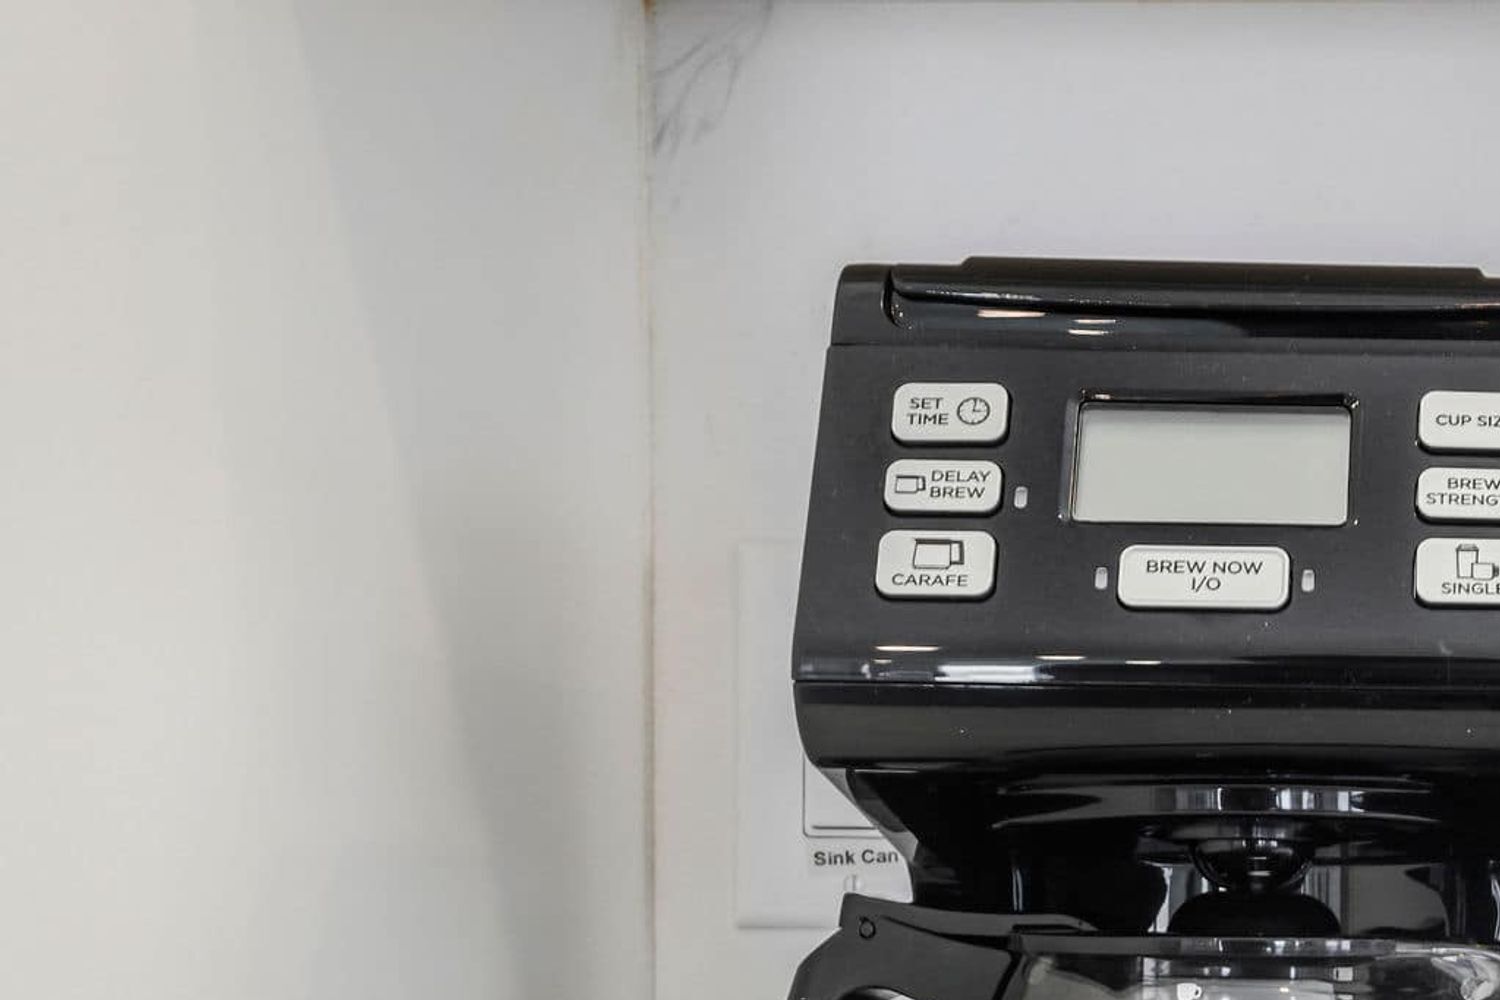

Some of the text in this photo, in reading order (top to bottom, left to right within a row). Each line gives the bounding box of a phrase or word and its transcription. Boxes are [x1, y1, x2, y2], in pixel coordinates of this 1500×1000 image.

[908, 397, 943, 410] SET
[907, 413, 949, 426] TIME
[1435, 414, 1472, 427] CUP
[931, 470, 992, 484] DELAY
[929, 486, 986, 499] BREW
[1146, 559, 1264, 575] BREW NOW
[891, 573, 968, 587] CARAFE
[1191, 576, 1221, 592] I/O
[814, 850, 899, 866] Sink Can
